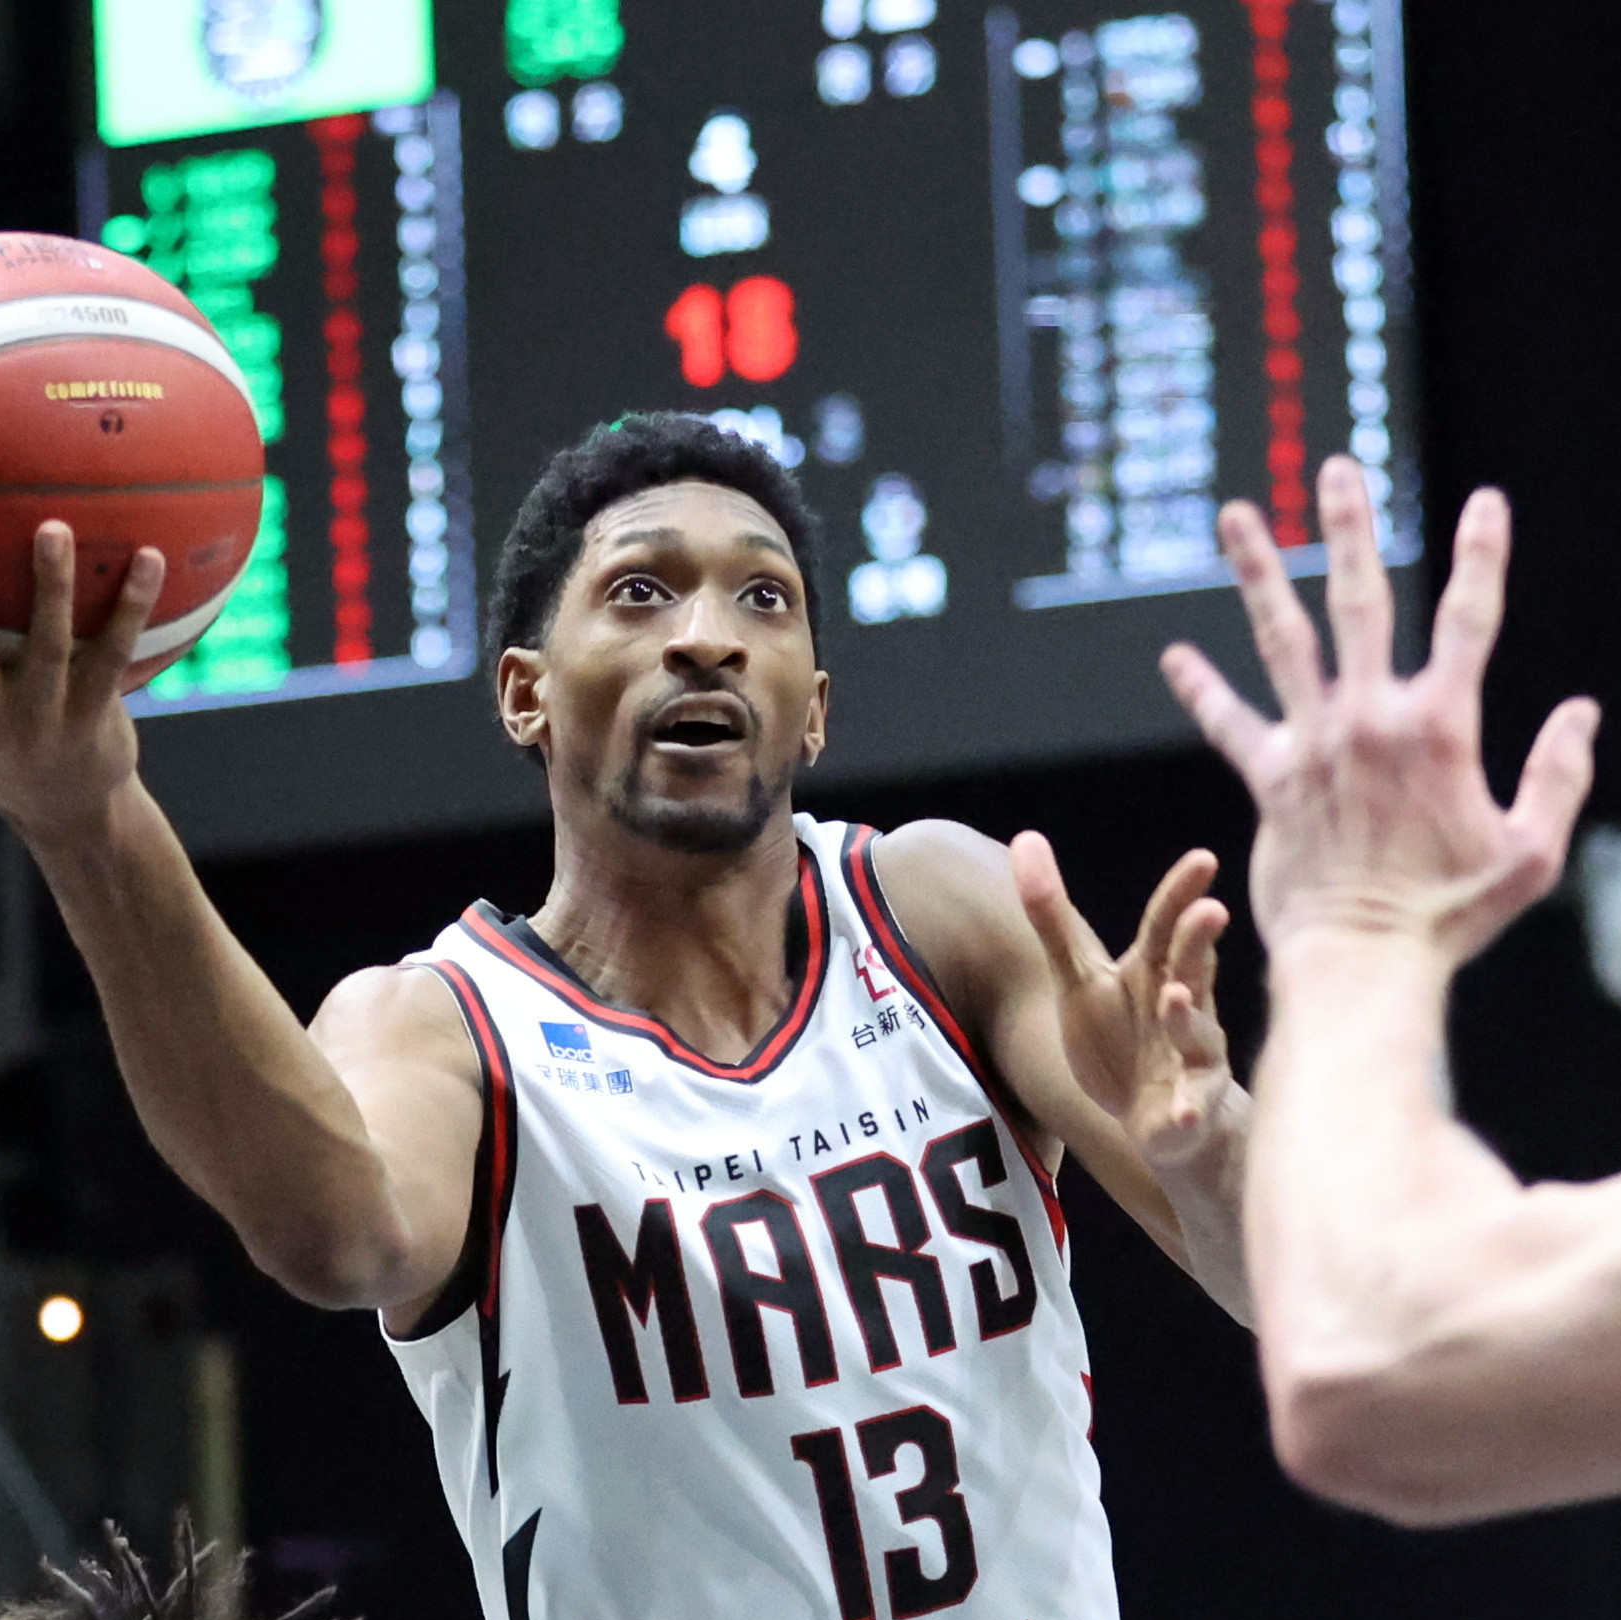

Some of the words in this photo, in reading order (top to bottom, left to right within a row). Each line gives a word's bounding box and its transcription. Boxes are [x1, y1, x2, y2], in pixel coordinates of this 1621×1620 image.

[44, 380, 164, 401] COMPETITION
[788, 1096, 931, 1161] TAISIN
[573, 1116, 1038, 1405] MARS
